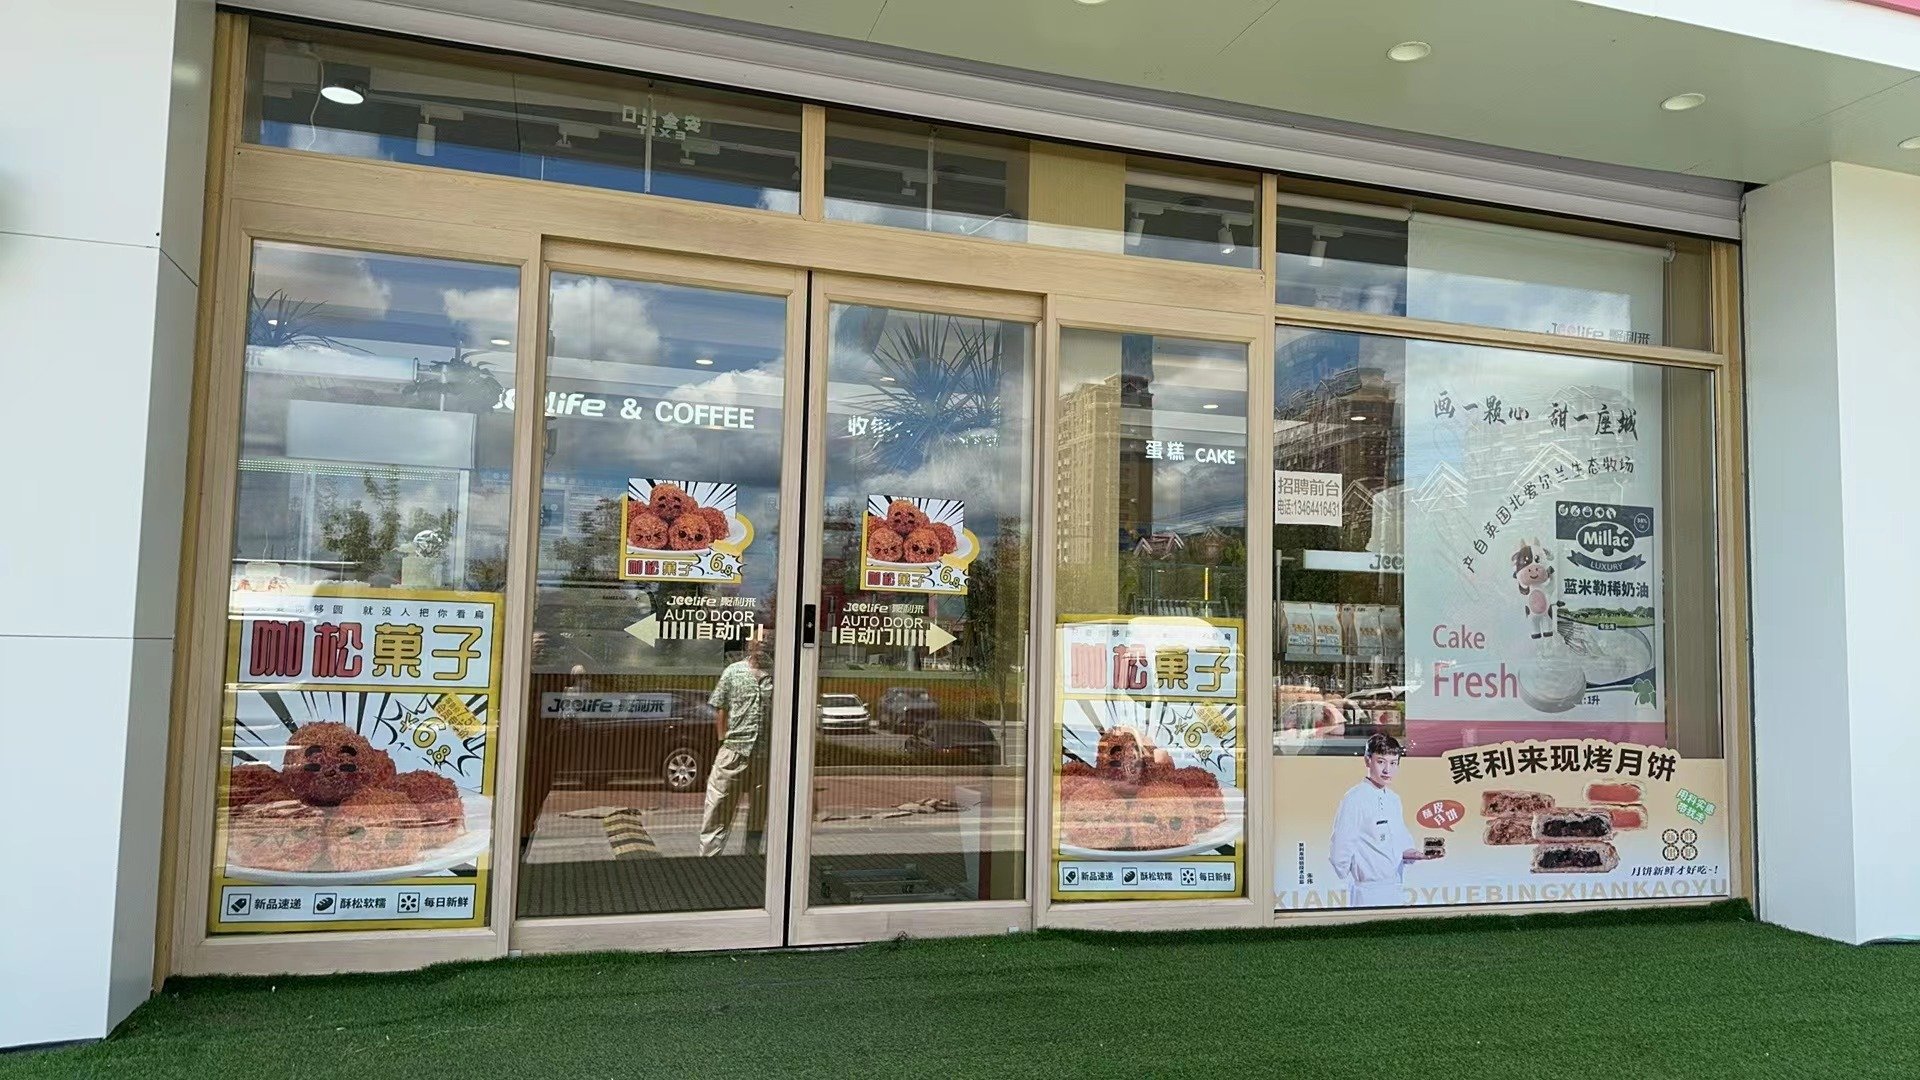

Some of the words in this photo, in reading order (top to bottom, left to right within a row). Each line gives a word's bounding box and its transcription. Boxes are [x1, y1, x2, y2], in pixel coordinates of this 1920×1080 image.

[620, 398, 642, 420] &
[655, 401, 755, 429] COFFEE
[1145, 440, 1185, 461] 蛋糕
[1195, 447, 1236, 465] CAKE
[1277, 477, 1340, 497] 招聘前台
[1583, 529, 1629, 547] Millac
[710, 553, 733, 576] 6.8
[1590, 561, 1623, 571] LUXURY
[940, 566, 960, 588] 6.8
[1563, 578, 1650, 599] 蓝米勒稀奶油
[666, 595, 716, 606] Jeelife
[843, 602, 889, 613] Jeelife
[663, 609, 706, 621] AUTO
[711, 610, 755, 623] DOOR
[840, 615, 880, 627] AUTO
[883, 617, 924, 629] DOOR
[696, 621, 755, 641] 自动门
[840, 626, 894, 645] 自动门
[1432, 624, 1486, 649] Cake
[1433, 662, 1518, 699] Fresh
[1448, 745, 1677, 784] 聚利来现烤月饼
[253, 898, 302, 910] 新品速递
[340, 897, 387, 909] 酥松软糯
[424, 896, 469, 908] 每日新鲜
